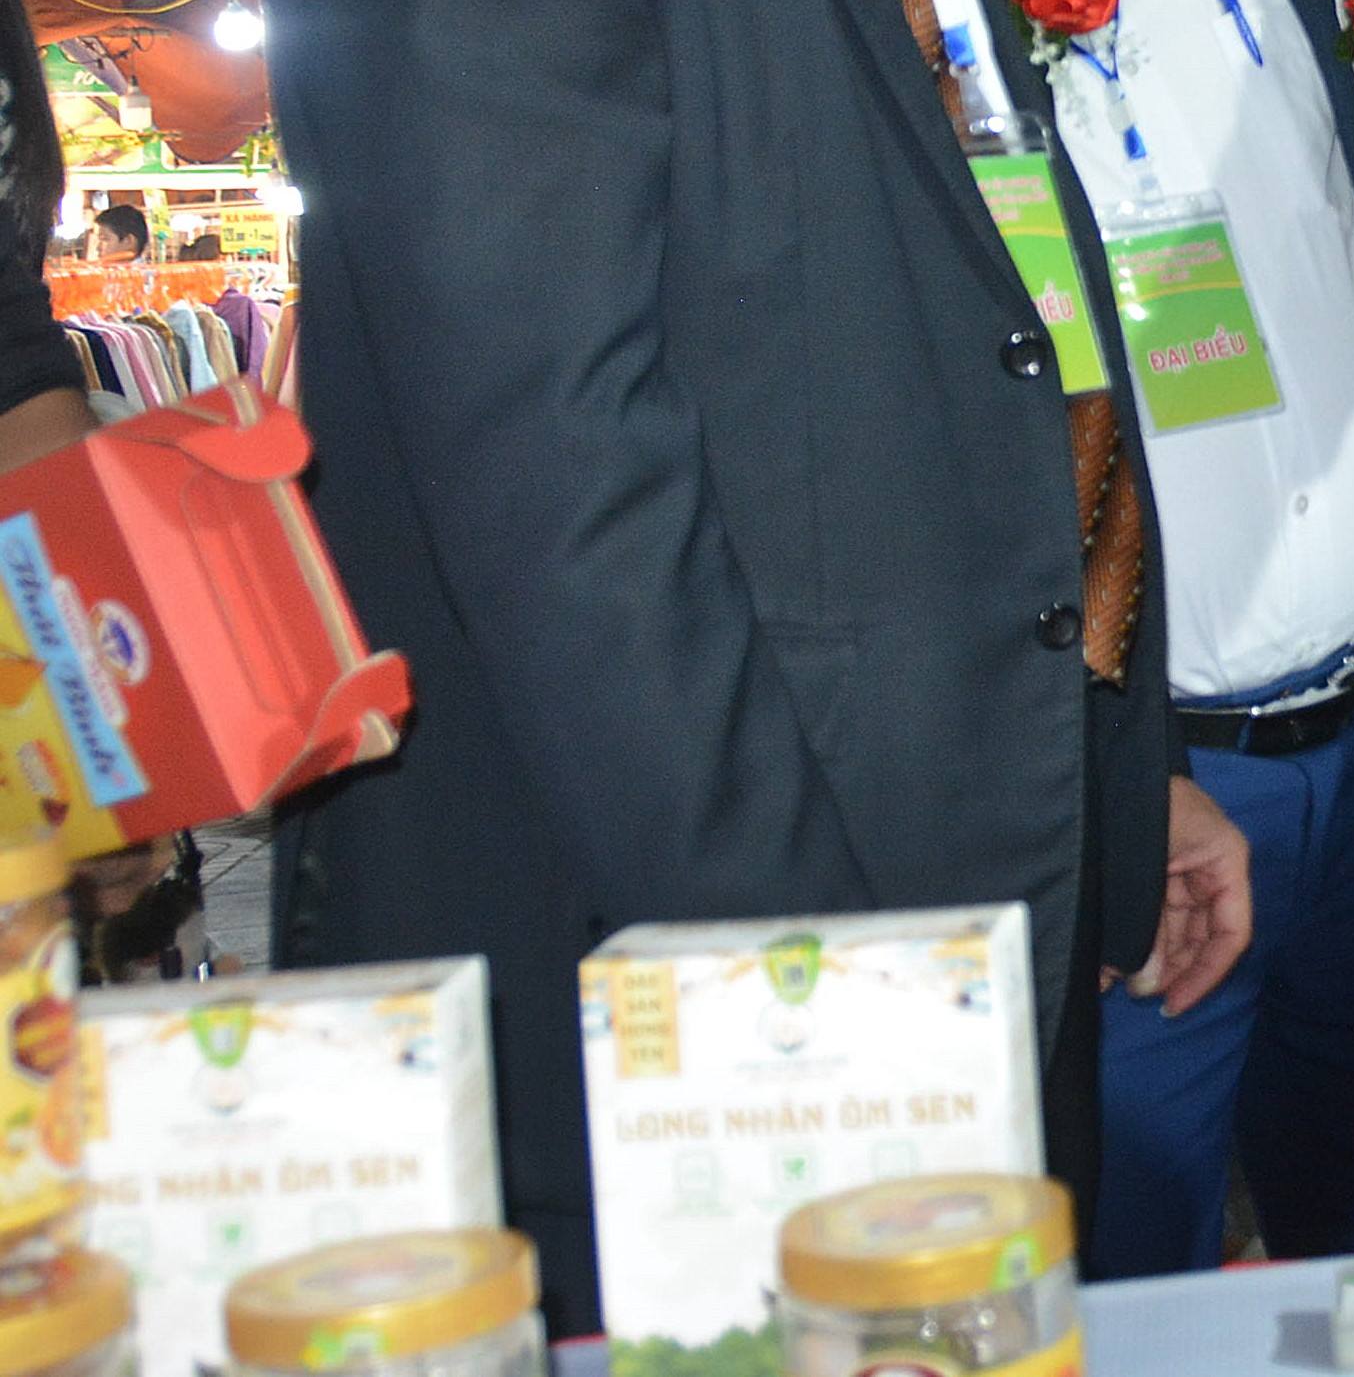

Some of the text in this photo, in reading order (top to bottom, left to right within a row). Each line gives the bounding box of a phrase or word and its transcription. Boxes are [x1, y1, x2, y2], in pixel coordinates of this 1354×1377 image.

[1034, 280, 1075, 323] IỂU
[1149, 324, 1248, 374] ĐẠI BIỂU
[614, 1109, 711, 1143] LONG
[906, 1090, 977, 1125] SEN
